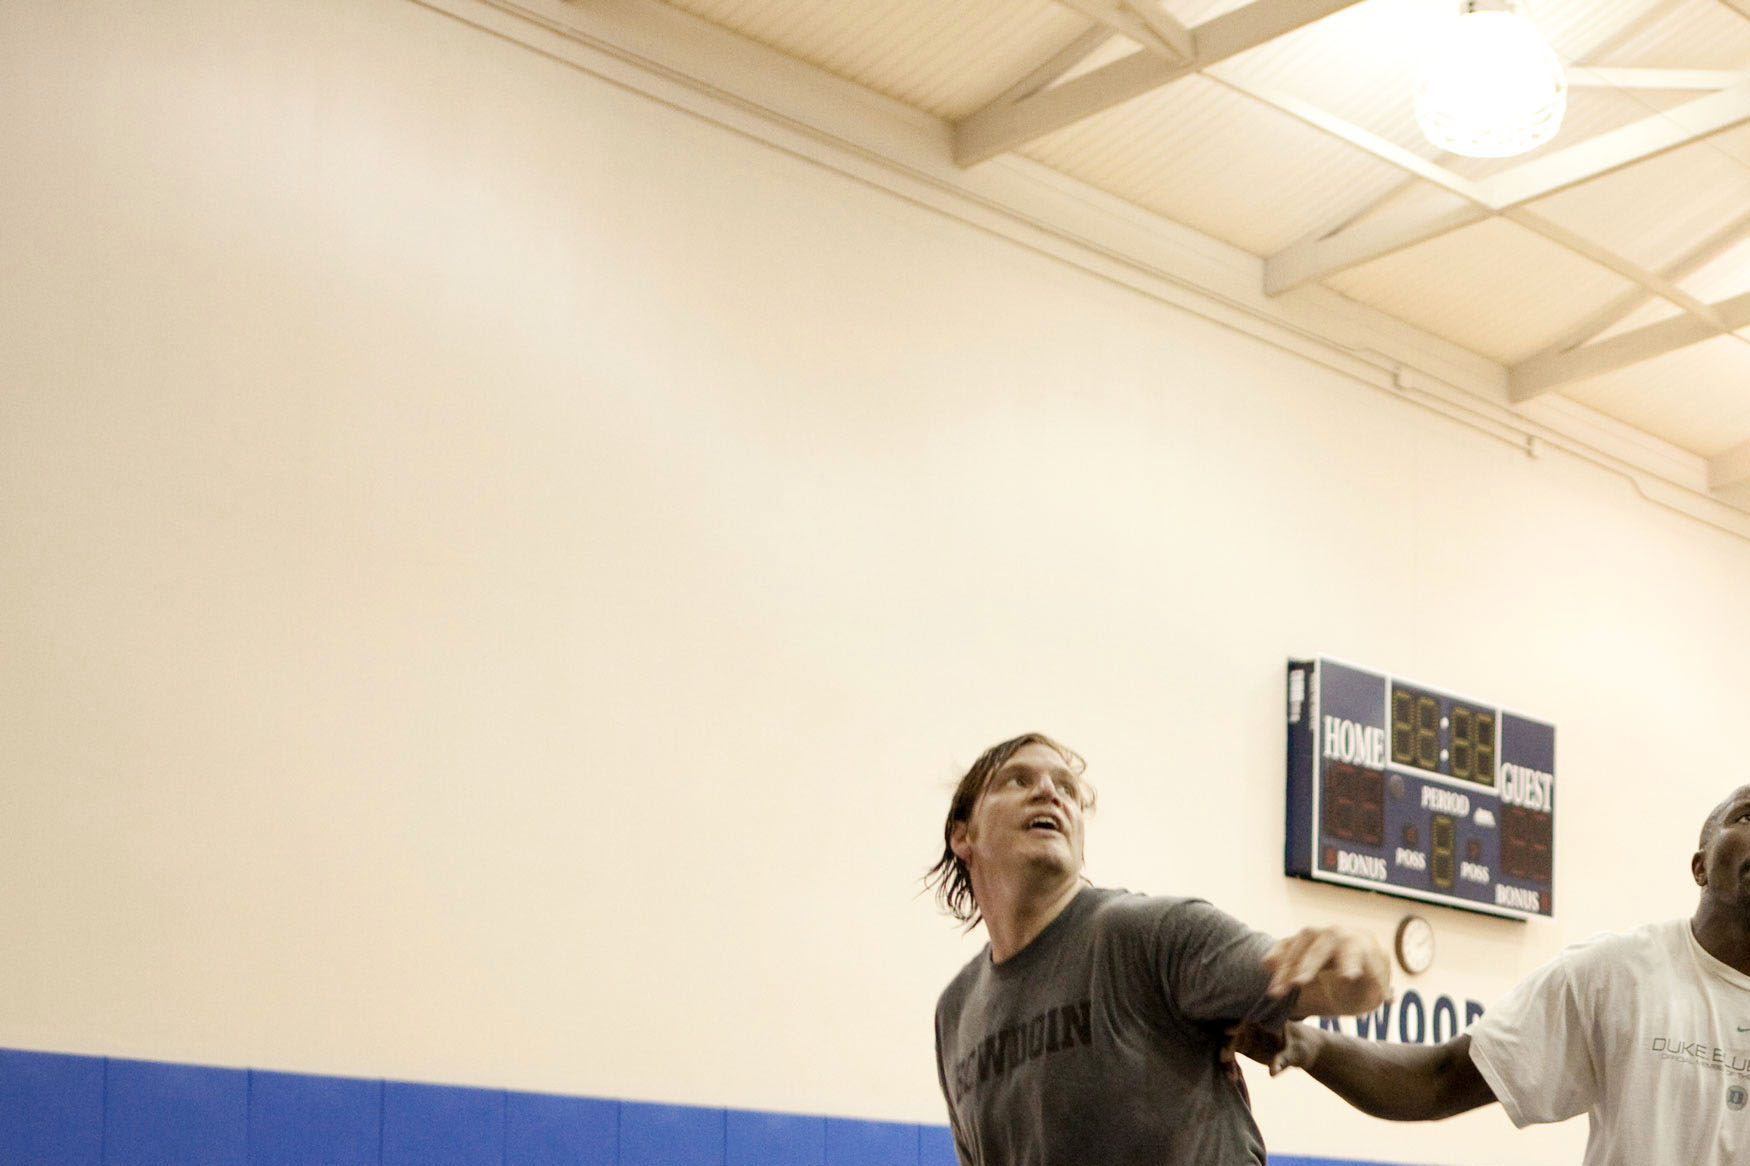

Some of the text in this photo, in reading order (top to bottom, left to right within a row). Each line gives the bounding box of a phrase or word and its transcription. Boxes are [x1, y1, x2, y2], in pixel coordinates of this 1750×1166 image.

[1323, 714, 1386, 770] HOME
[1420, 785, 1470, 817] PERIOD
[1500, 762, 1554, 812] GUEST
[1337, 850, 1387, 880] BONUS
[1395, 847, 1426, 871] POSS
[1460, 861, 1490, 884] POSS
[1494, 883, 1540, 911] BONUS
[1652, 1037, 1707, 1059] DUKE
